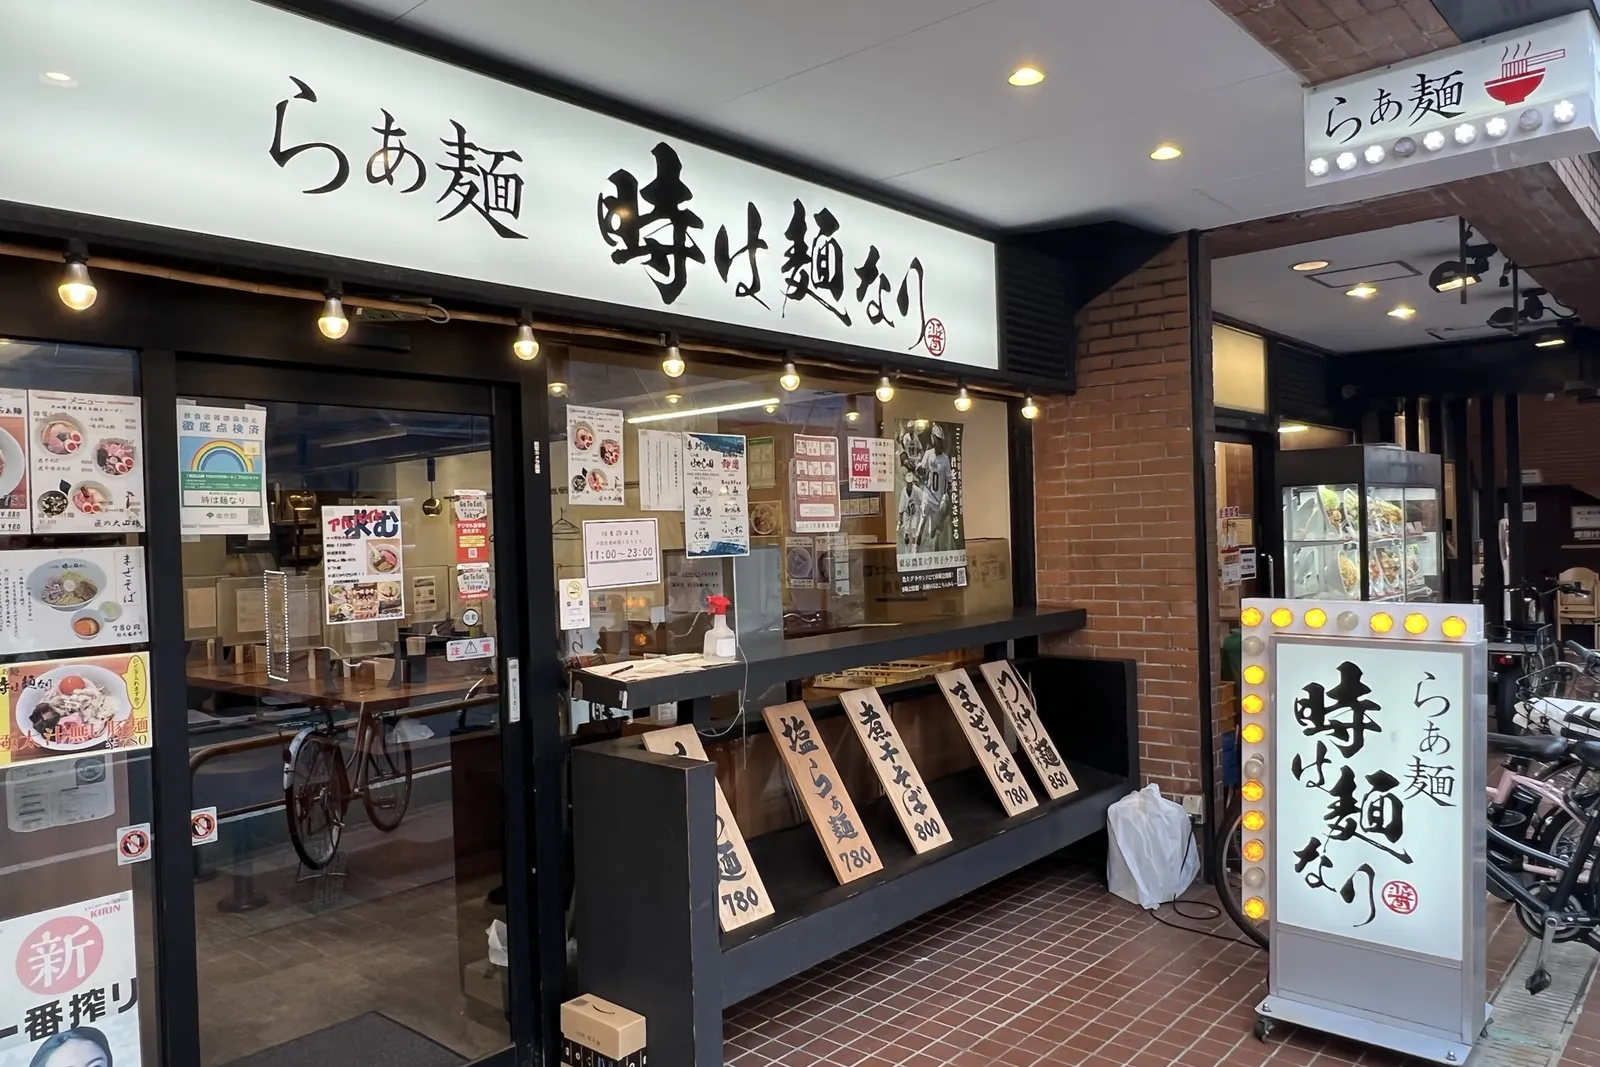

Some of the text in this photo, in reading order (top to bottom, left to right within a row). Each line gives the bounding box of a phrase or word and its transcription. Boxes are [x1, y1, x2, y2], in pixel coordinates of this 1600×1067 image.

[1325, 70, 1466, 143] らぁ麺
[269, 76, 529, 239] らぁ麺
[597, 142, 927, 350] 時は麺なり
[182, 421, 259, 434] 徹底点検済
[852, 453, 869, 461] TAKE
[854, 463, 868, 471] OUT
[859, 701, 928, 817] 煮干そば
[1403, 671, 1457, 807] らぁ麺
[780, 716, 858, 844] 塩らぁ麺
[1004, 785, 1029, 807] 780
[1048, 771, 1069, 790] 850
[1291, 661, 1414, 927] 時は麺なり
[914, 818, 940, 842] 800
[839, 845, 872, 872] 780
[90, 904, 121, 919] KIRIN
[721, 886, 759, 916] 780
[28, 925, 95, 988] 新
[0, 978, 137, 1042] 一番搾り
